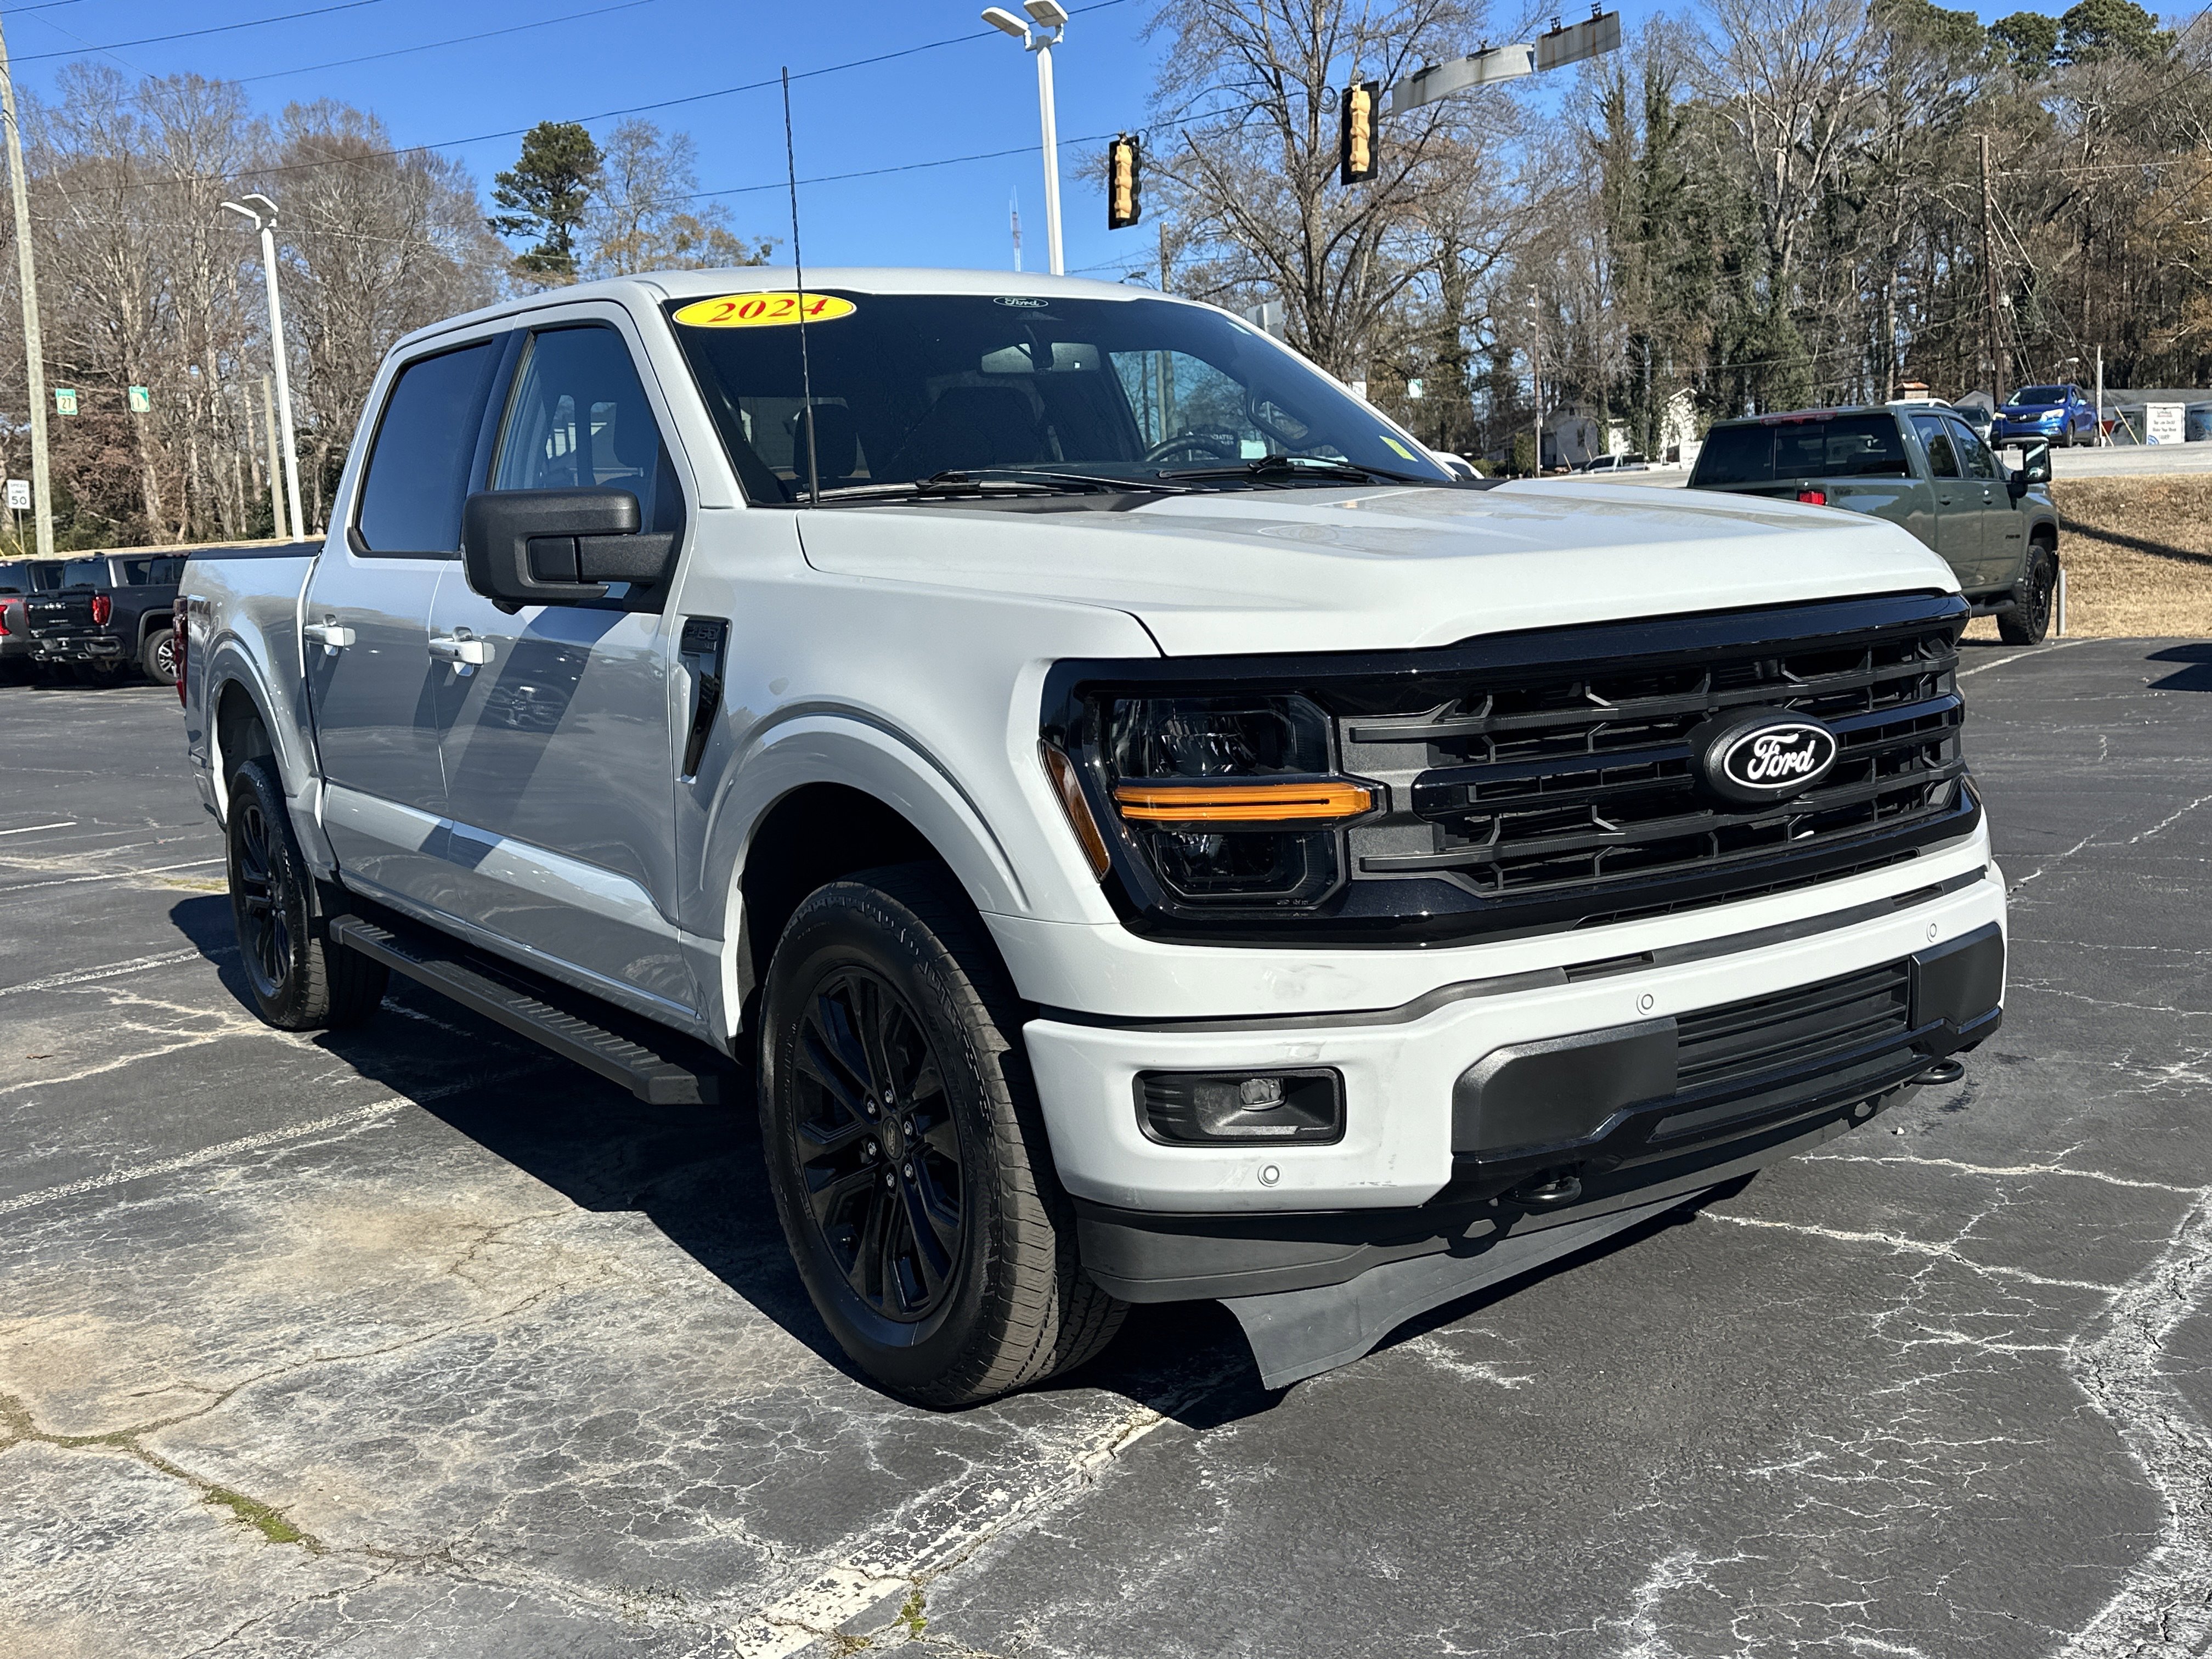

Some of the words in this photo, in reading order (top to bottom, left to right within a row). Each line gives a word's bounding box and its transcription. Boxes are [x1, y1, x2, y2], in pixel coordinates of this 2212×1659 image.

[1005, 297, 1040, 307] Ford
[707, 297, 830, 323] 2024
[61, 398, 71, 409] 27
[12, 496, 27, 505] 50
[1747, 733, 1815, 780] Ford
